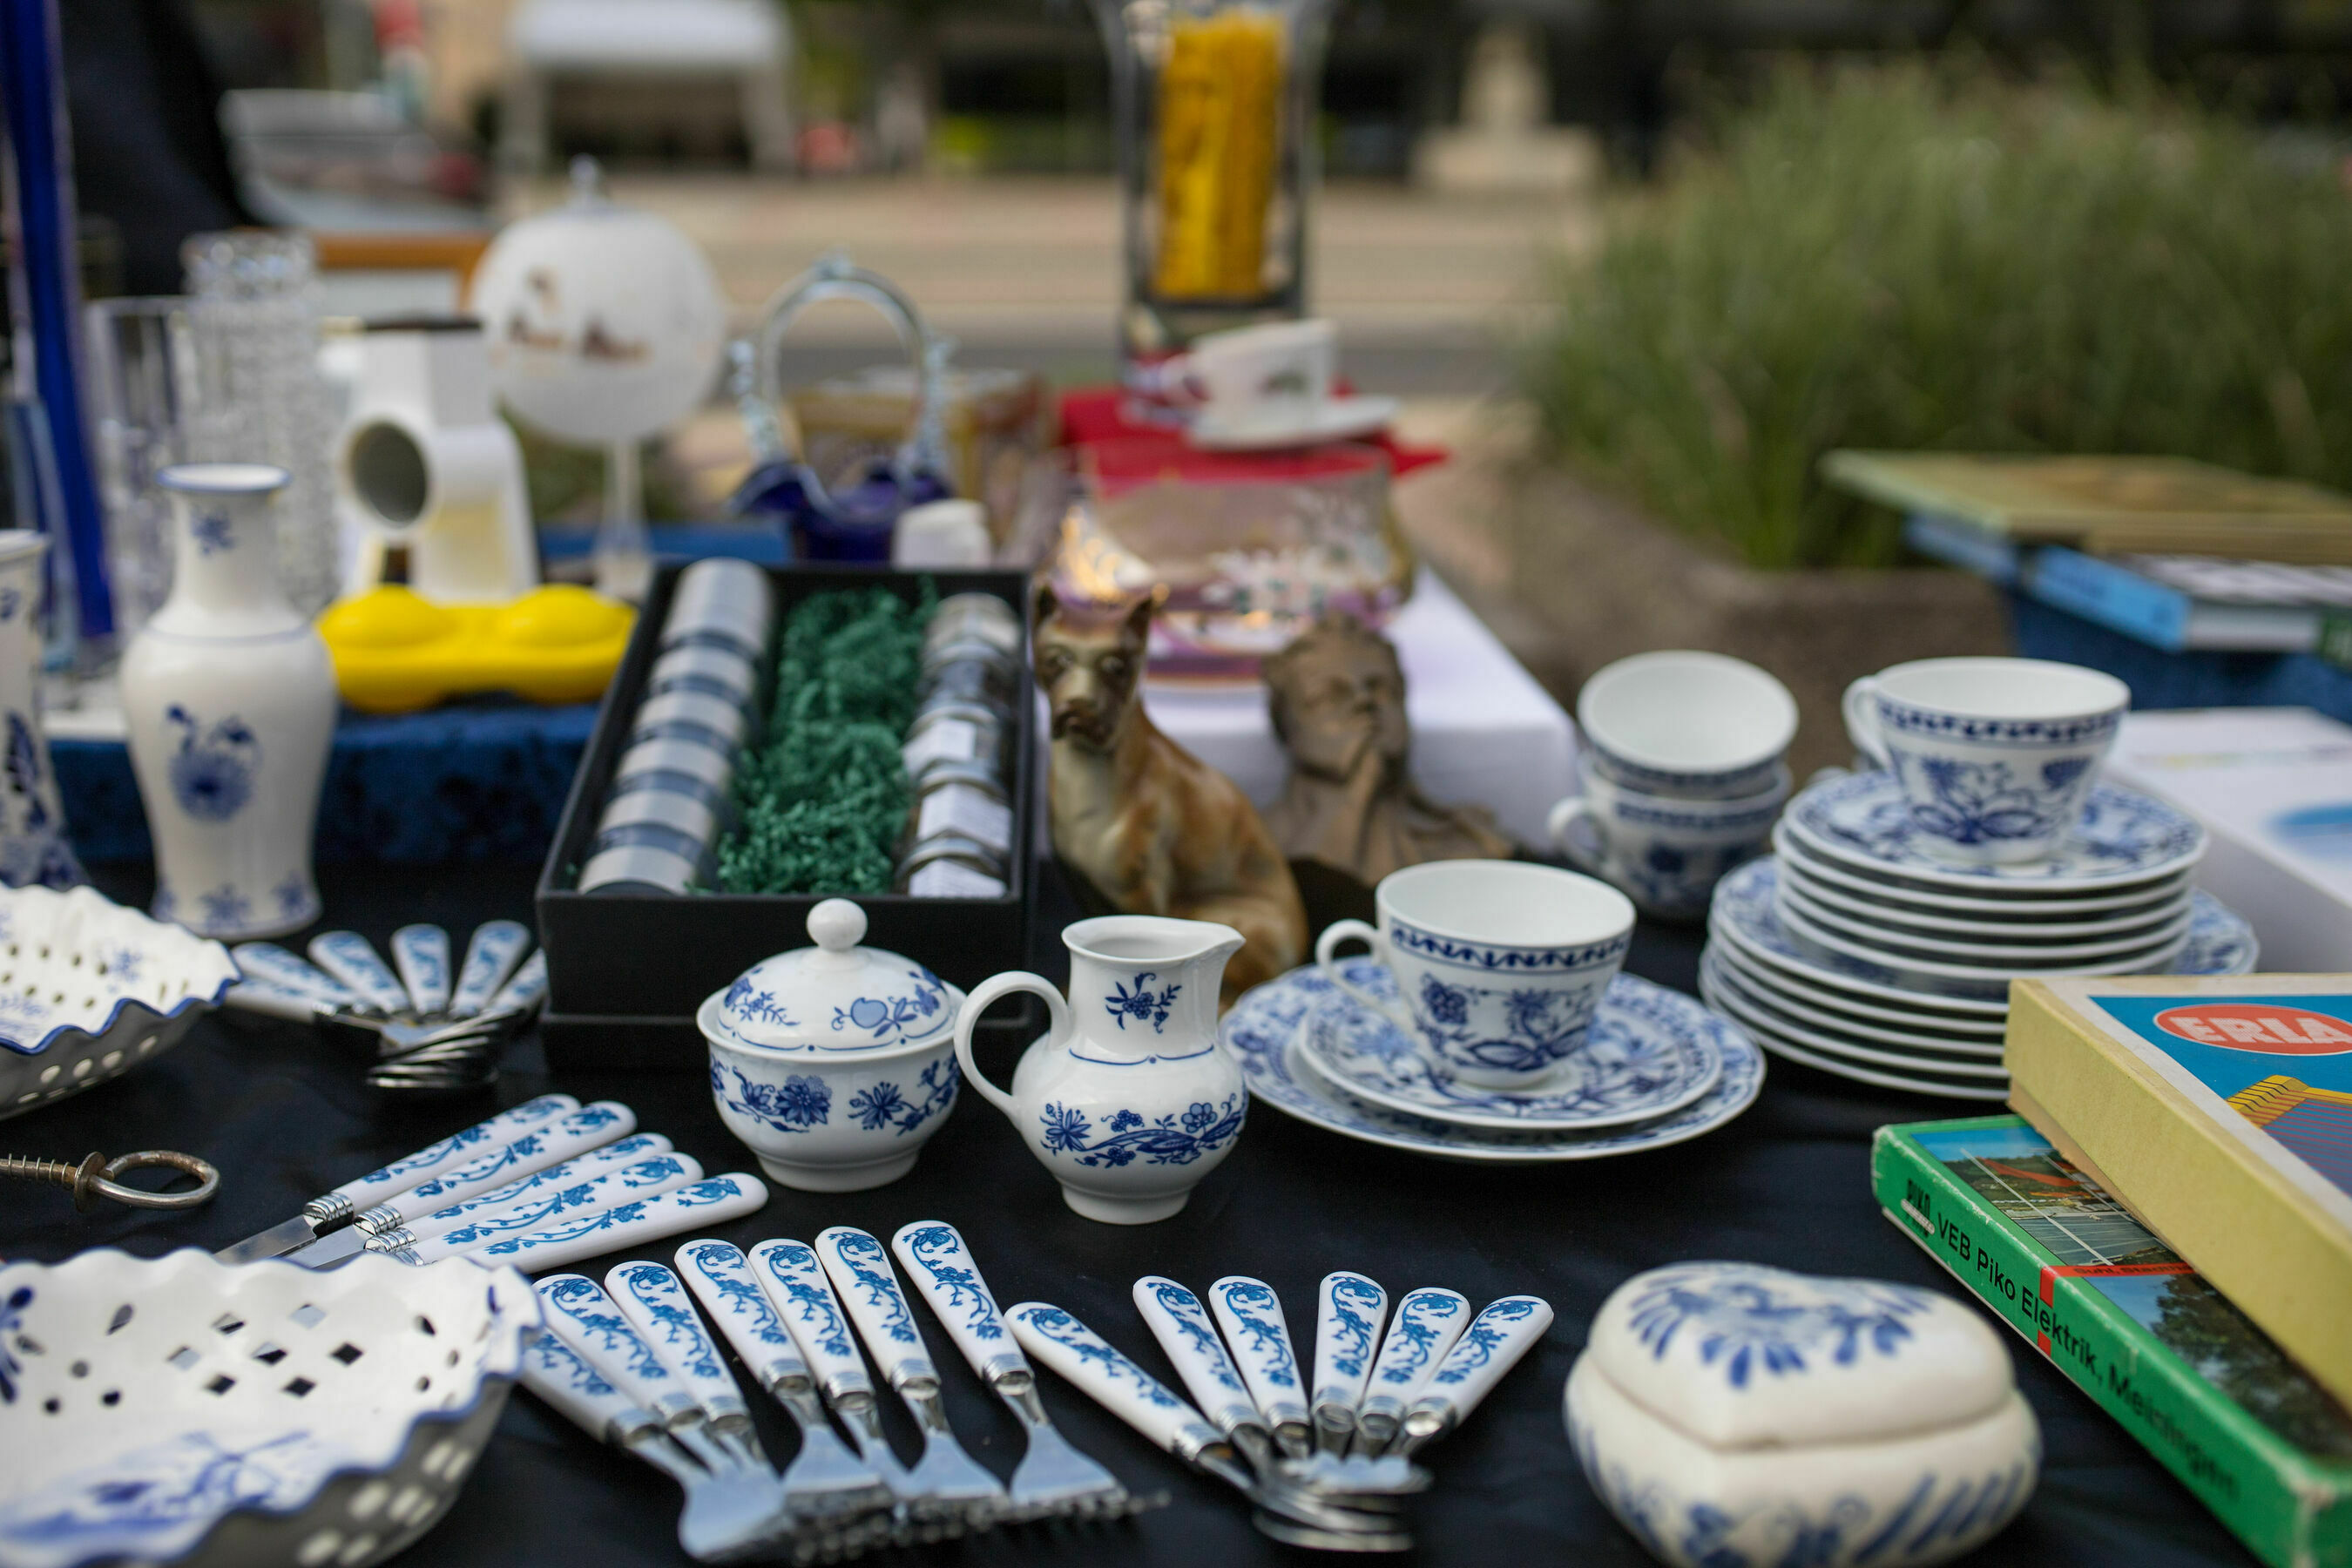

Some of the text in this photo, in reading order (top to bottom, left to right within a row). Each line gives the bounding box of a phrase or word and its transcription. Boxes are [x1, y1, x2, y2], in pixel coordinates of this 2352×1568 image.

[2168, 1016, 2352, 1044] ERLA
[1937, 1212, 1971, 1261] VEB
[1977, 1247, 2016, 1301] Piko
[2021, 1285, 2104, 1386] Elektrik,
